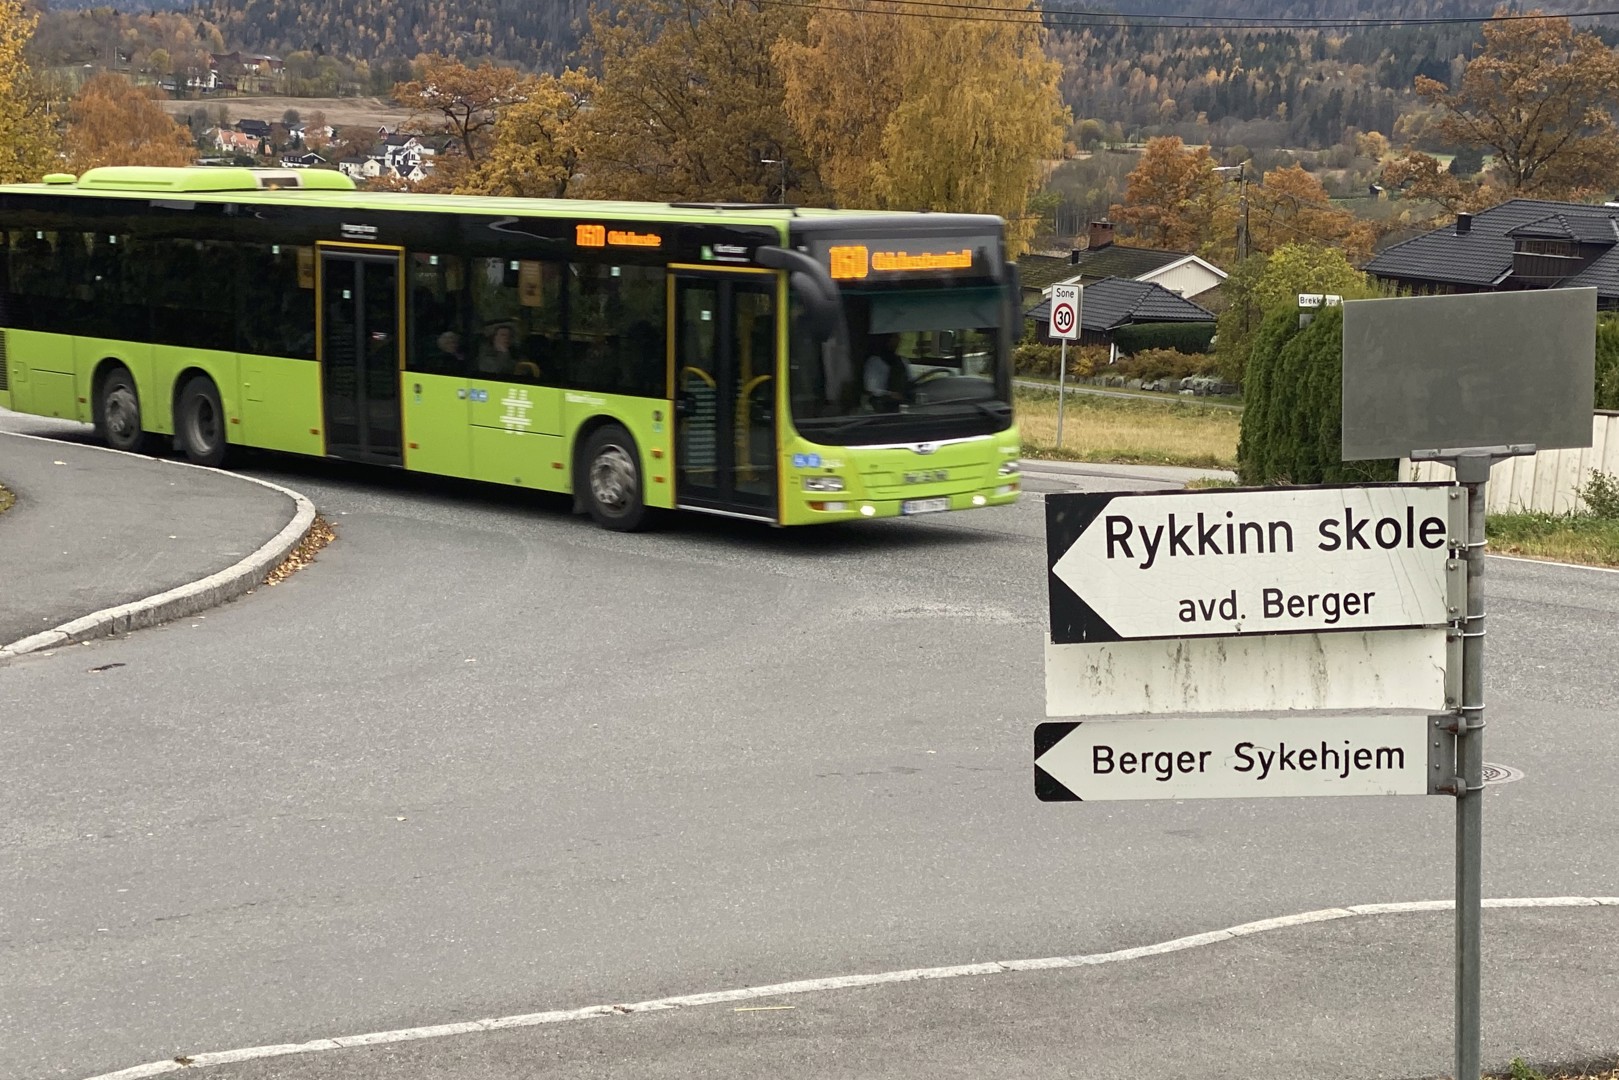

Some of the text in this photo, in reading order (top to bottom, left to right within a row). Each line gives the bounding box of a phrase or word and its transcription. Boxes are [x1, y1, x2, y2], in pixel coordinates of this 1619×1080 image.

[1056, 288, 1075, 299] Sone
[1057, 310, 1071, 327] 30
[1106, 506, 1448, 570] Rykkinn skole
[1178, 588, 1376, 623] avd. Berger
[1092, 741, 1405, 782] Berger Sykehjem
